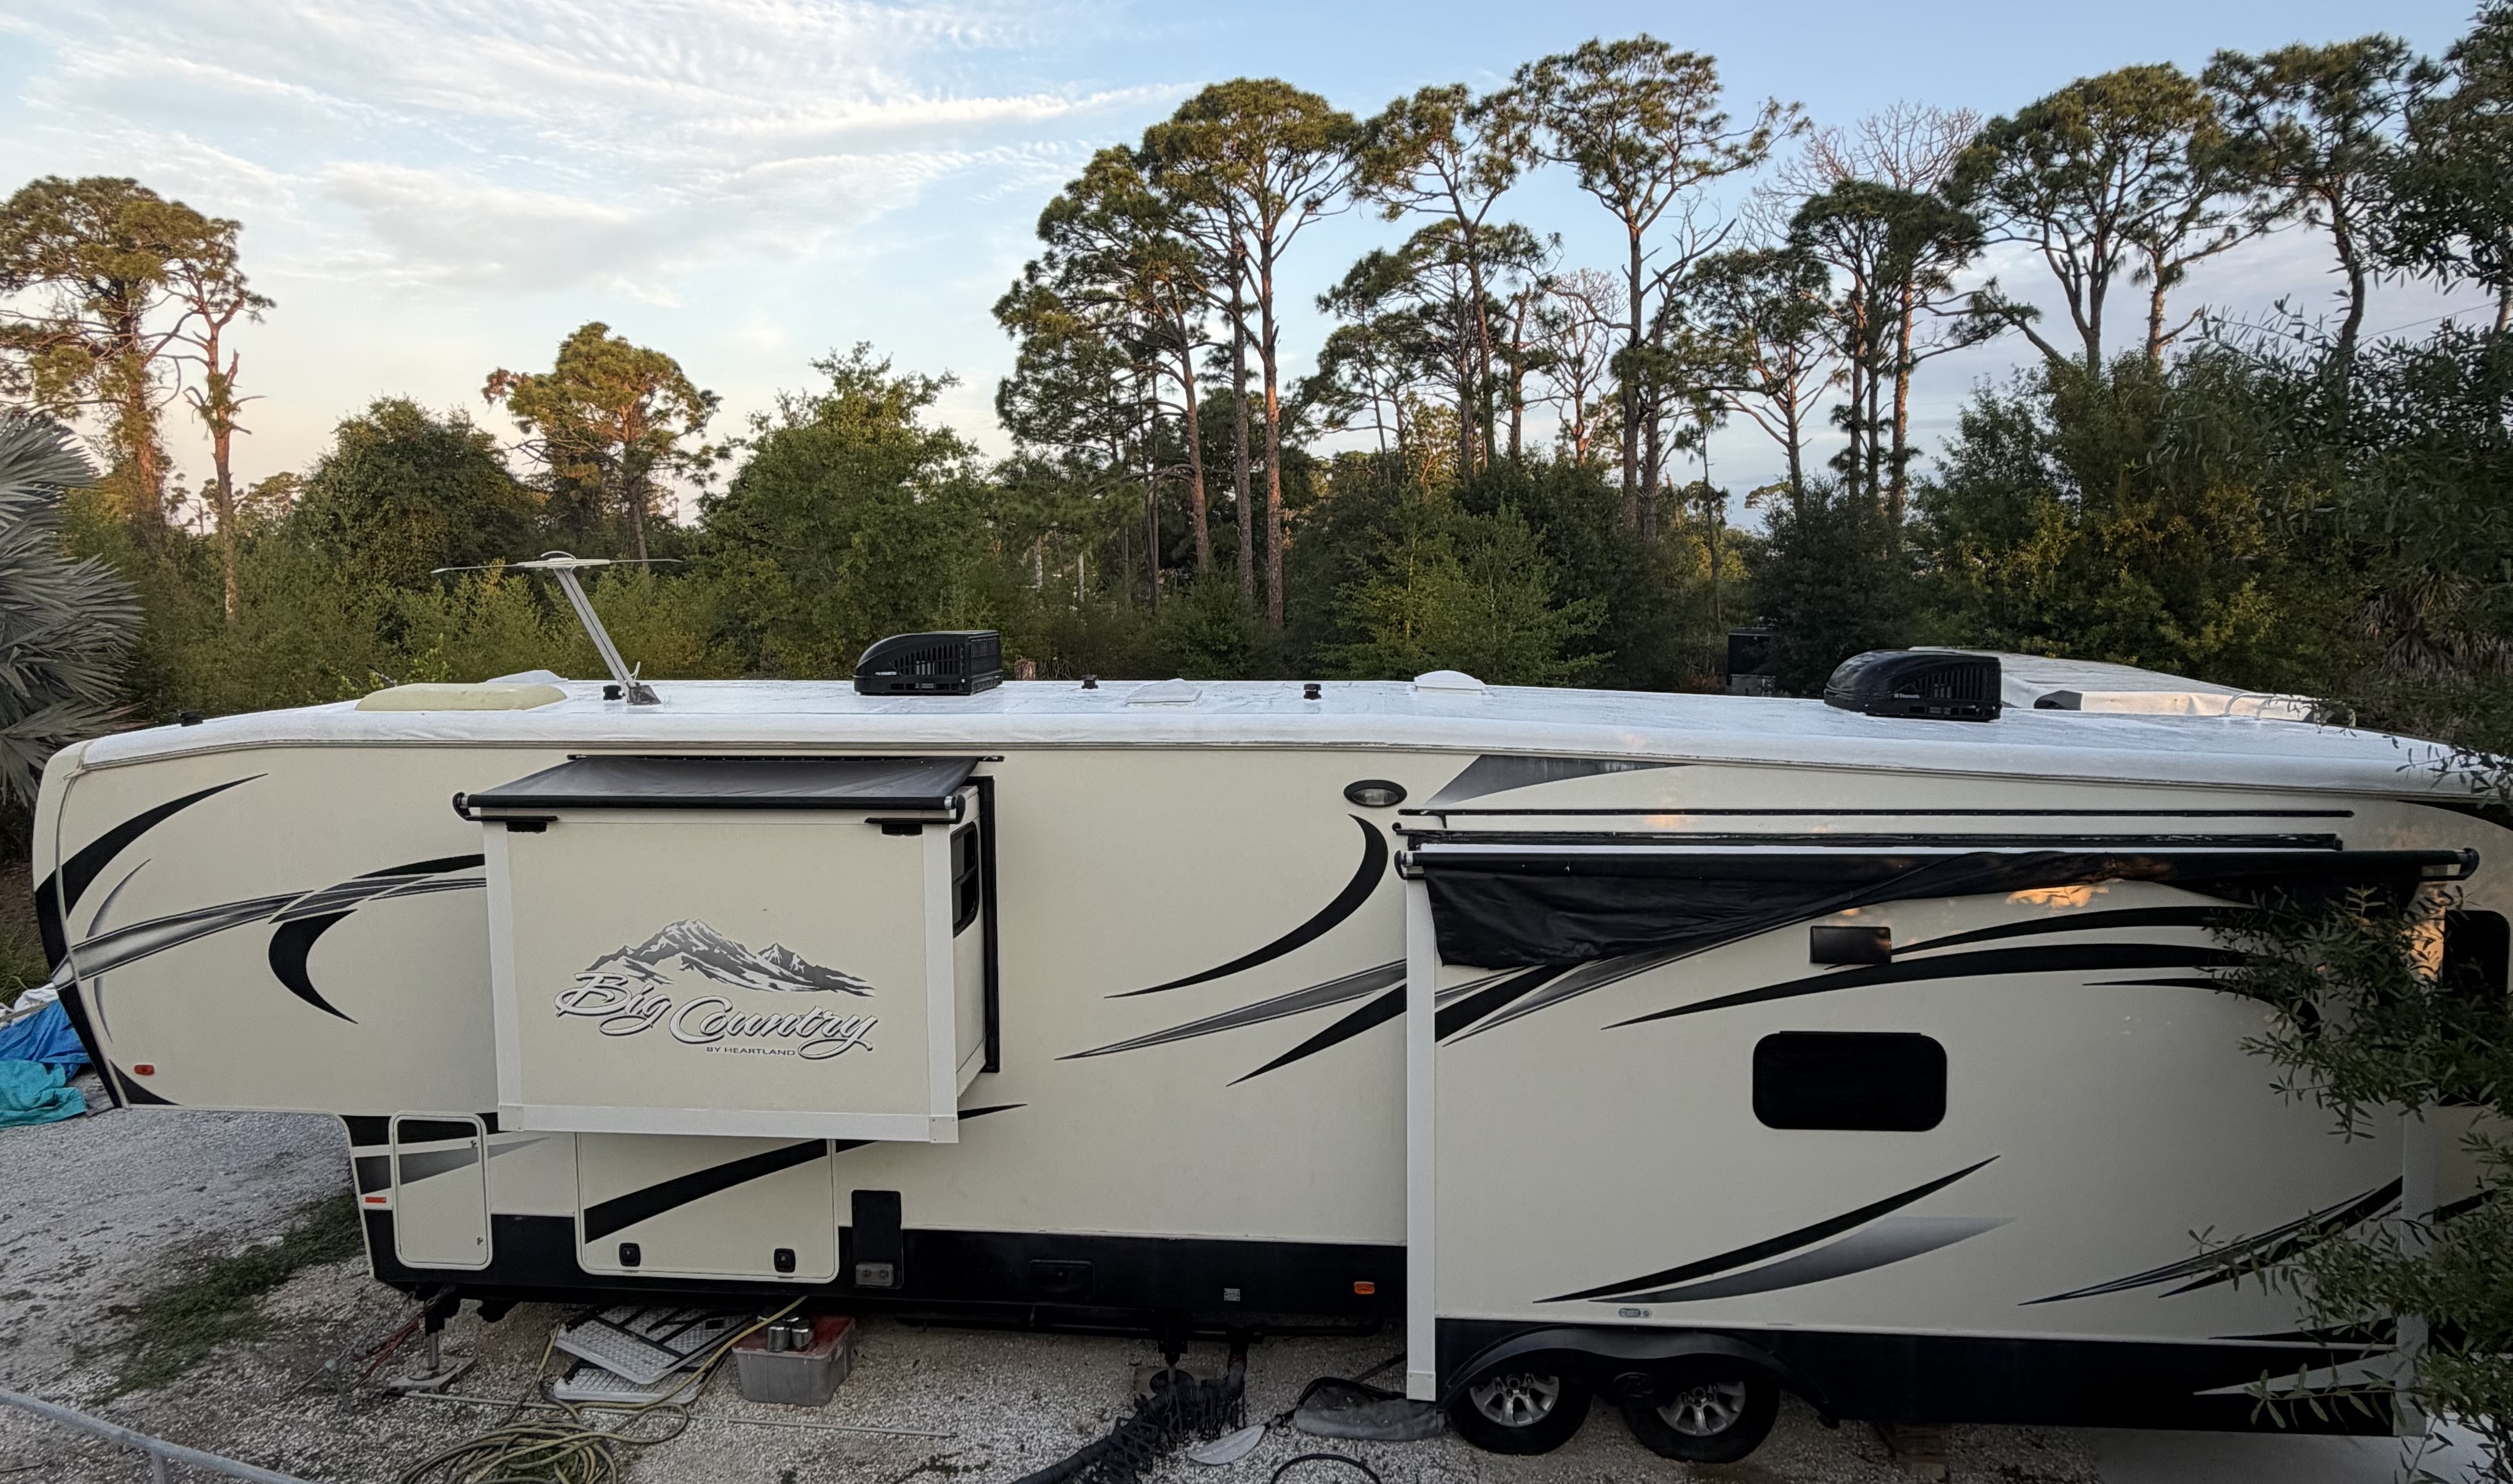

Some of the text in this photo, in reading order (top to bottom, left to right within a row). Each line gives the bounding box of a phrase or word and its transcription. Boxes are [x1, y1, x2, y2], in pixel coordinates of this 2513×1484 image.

[554, 972, 878, 1060] Big Country
[724, 1047, 795, 1055] HEARTLAND
